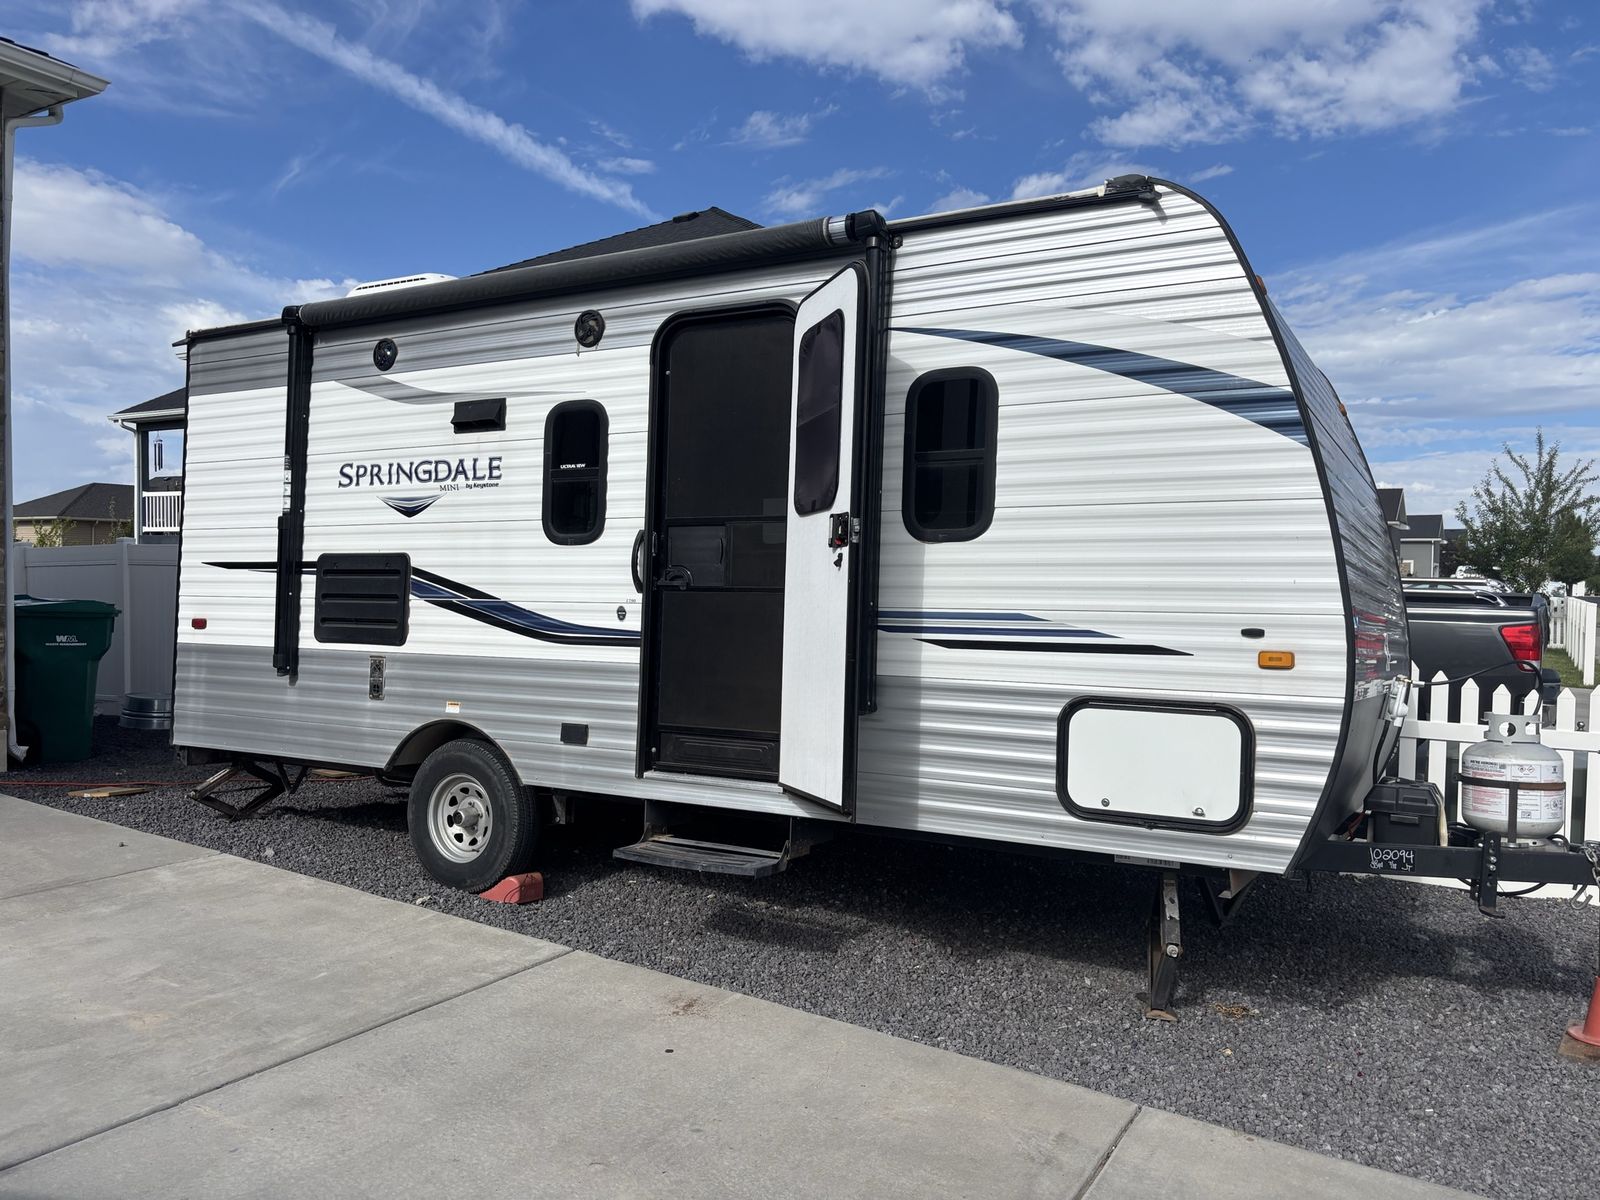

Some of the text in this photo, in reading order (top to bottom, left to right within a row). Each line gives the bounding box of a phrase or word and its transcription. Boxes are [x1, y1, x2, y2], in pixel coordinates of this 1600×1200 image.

[338, 456, 503, 488] SPRINGDALE
[439, 484, 460, 492] MINI
[1369, 847, 1415, 864] 102094
